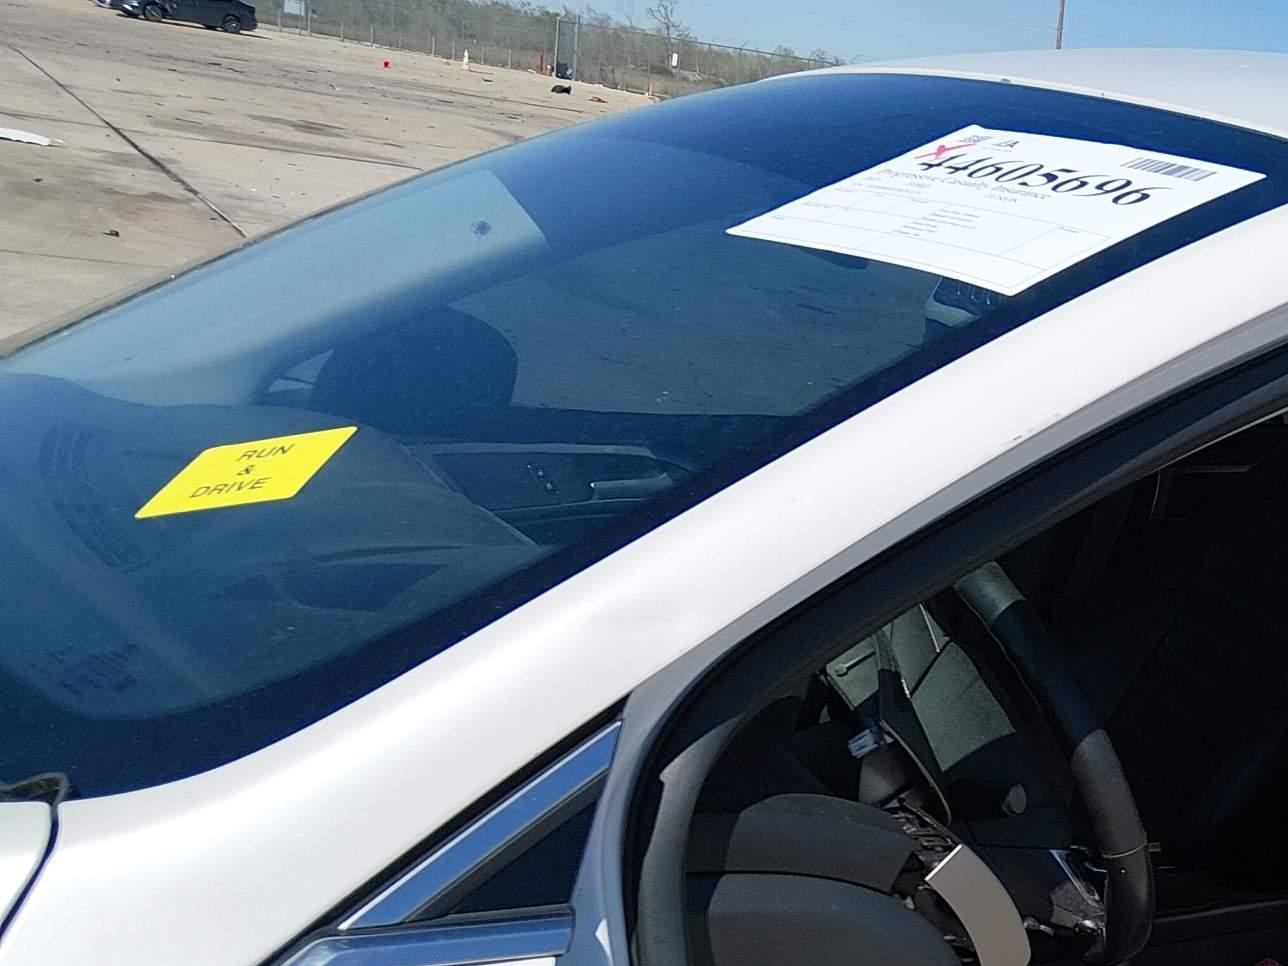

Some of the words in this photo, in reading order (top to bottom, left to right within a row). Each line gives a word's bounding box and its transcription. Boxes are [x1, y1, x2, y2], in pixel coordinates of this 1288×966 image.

[917, 153, 1174, 206] 44605696
[236, 444, 295, 461] RUN
[236, 465, 256, 476] &
[189, 477, 272, 498] DRIVE
